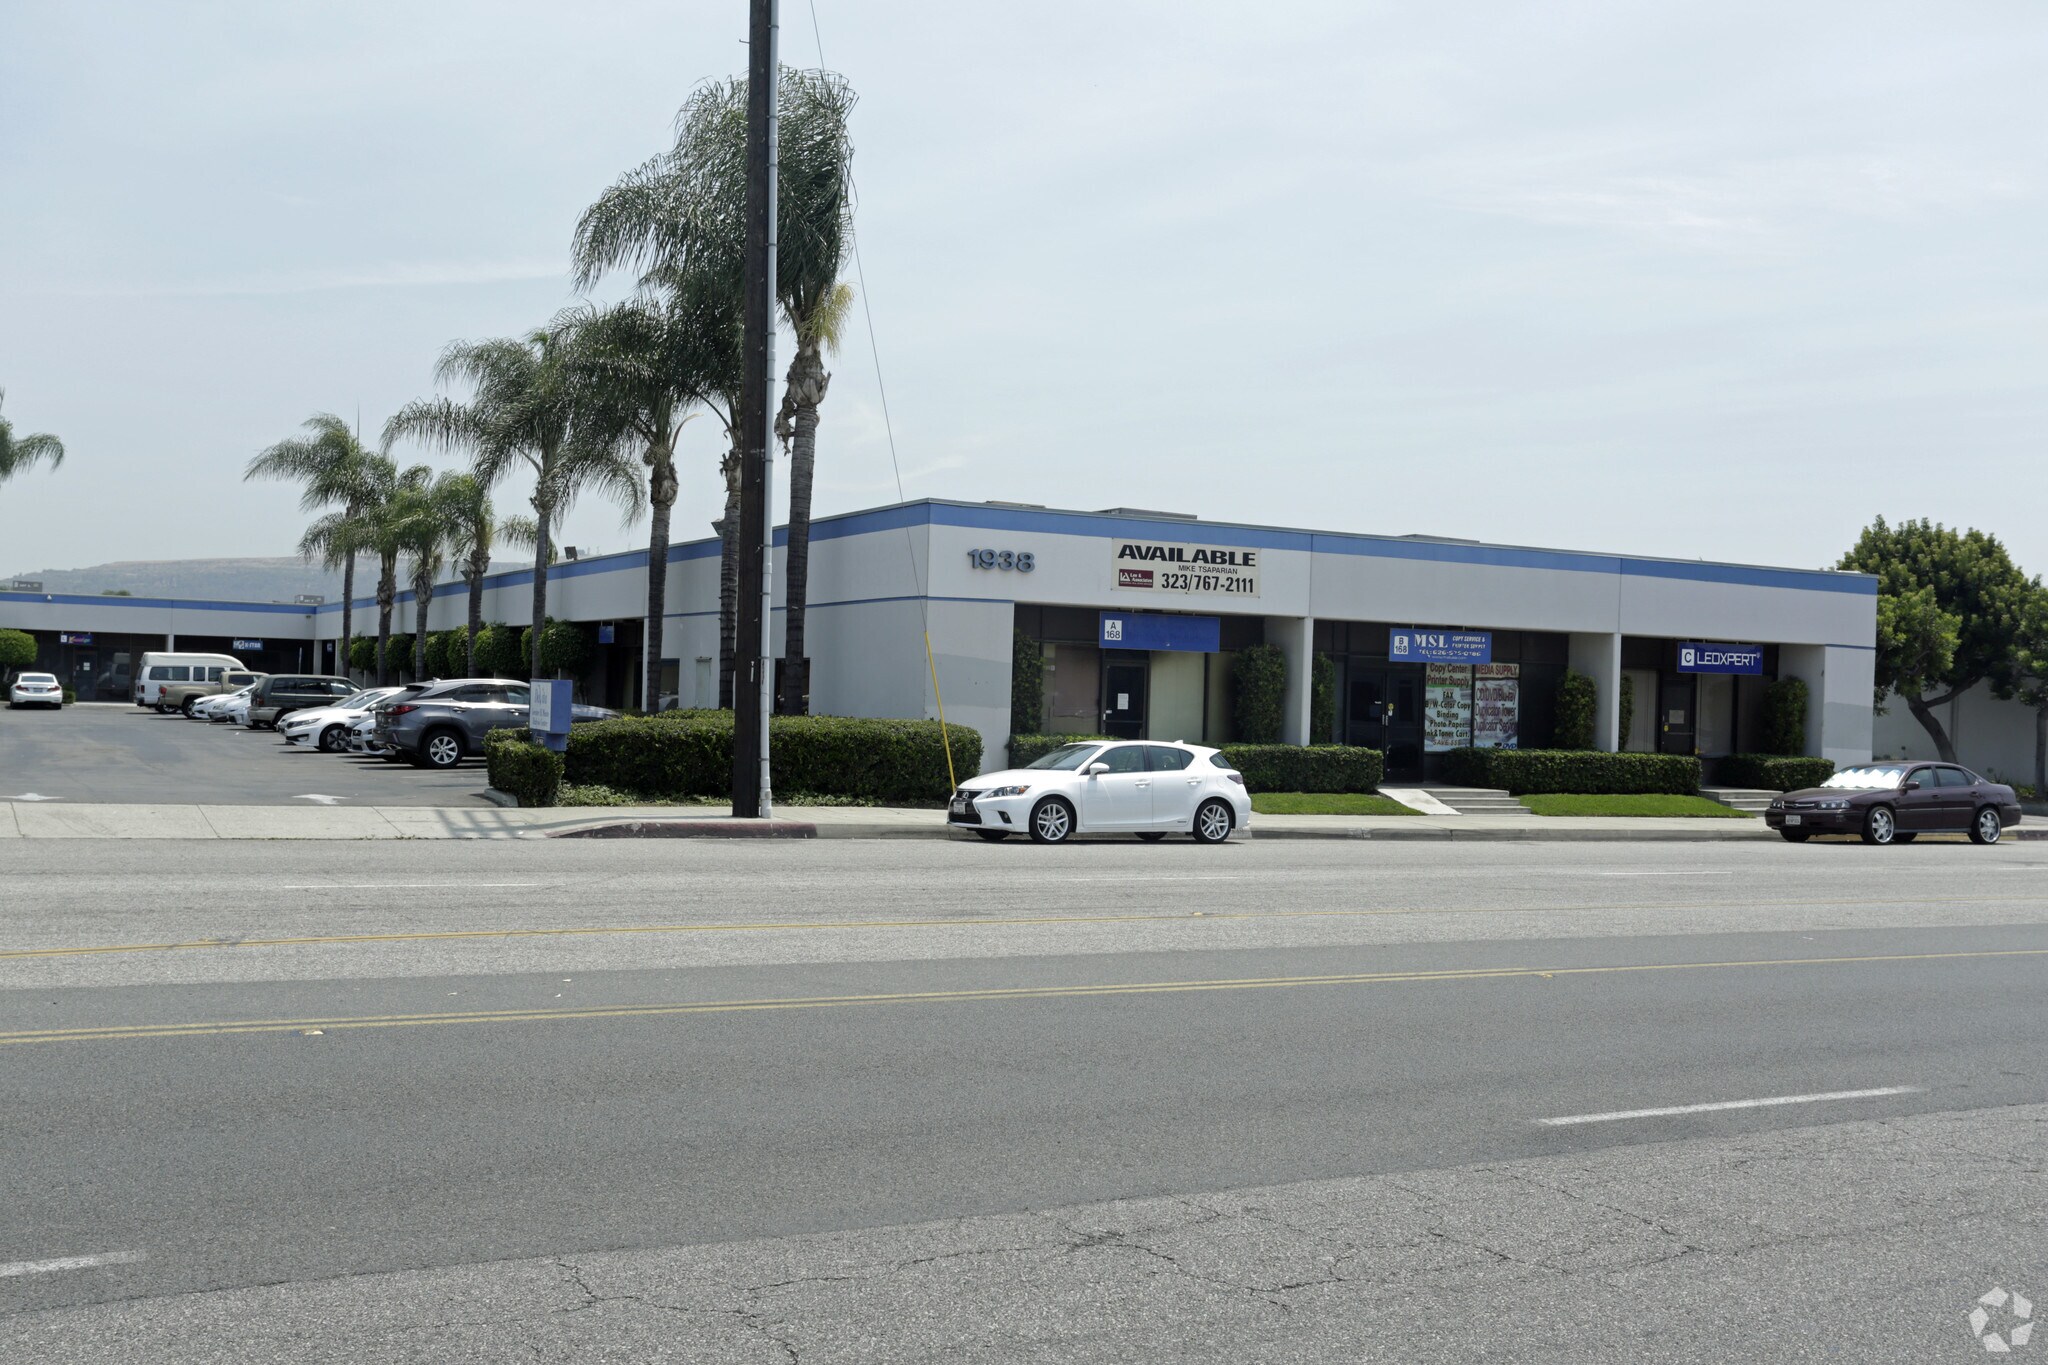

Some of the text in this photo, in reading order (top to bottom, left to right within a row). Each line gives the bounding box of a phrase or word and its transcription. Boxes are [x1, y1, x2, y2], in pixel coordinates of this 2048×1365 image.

[967, 549, 1035, 573] 1938
[1118, 544, 1256, 567] AVAILABLE
[1178, 565, 1238, 575] MIKE TSAPARIAN
[1161, 573, 1254, 593] 323/767-2111
[1110, 621, 1117, 630] A
[1106, 630, 1121, 639] 168
[1414, 634, 1448, 648] MSL
[1684, 651, 1692, 663] C
[1697, 651, 1757, 666] LEDXPERT
[1430, 662, 1468, 675] Copy Center
[1495, 664, 1518, 676] SUPPLY
[1427, 674, 1470, 688] Printer Supply
[1442, 691, 1454, 699] FAX
[1457, 701, 1471, 711] Copy
[1436, 710, 1459, 720] Binding
[1430, 720, 1465, 730] Photo Paper
